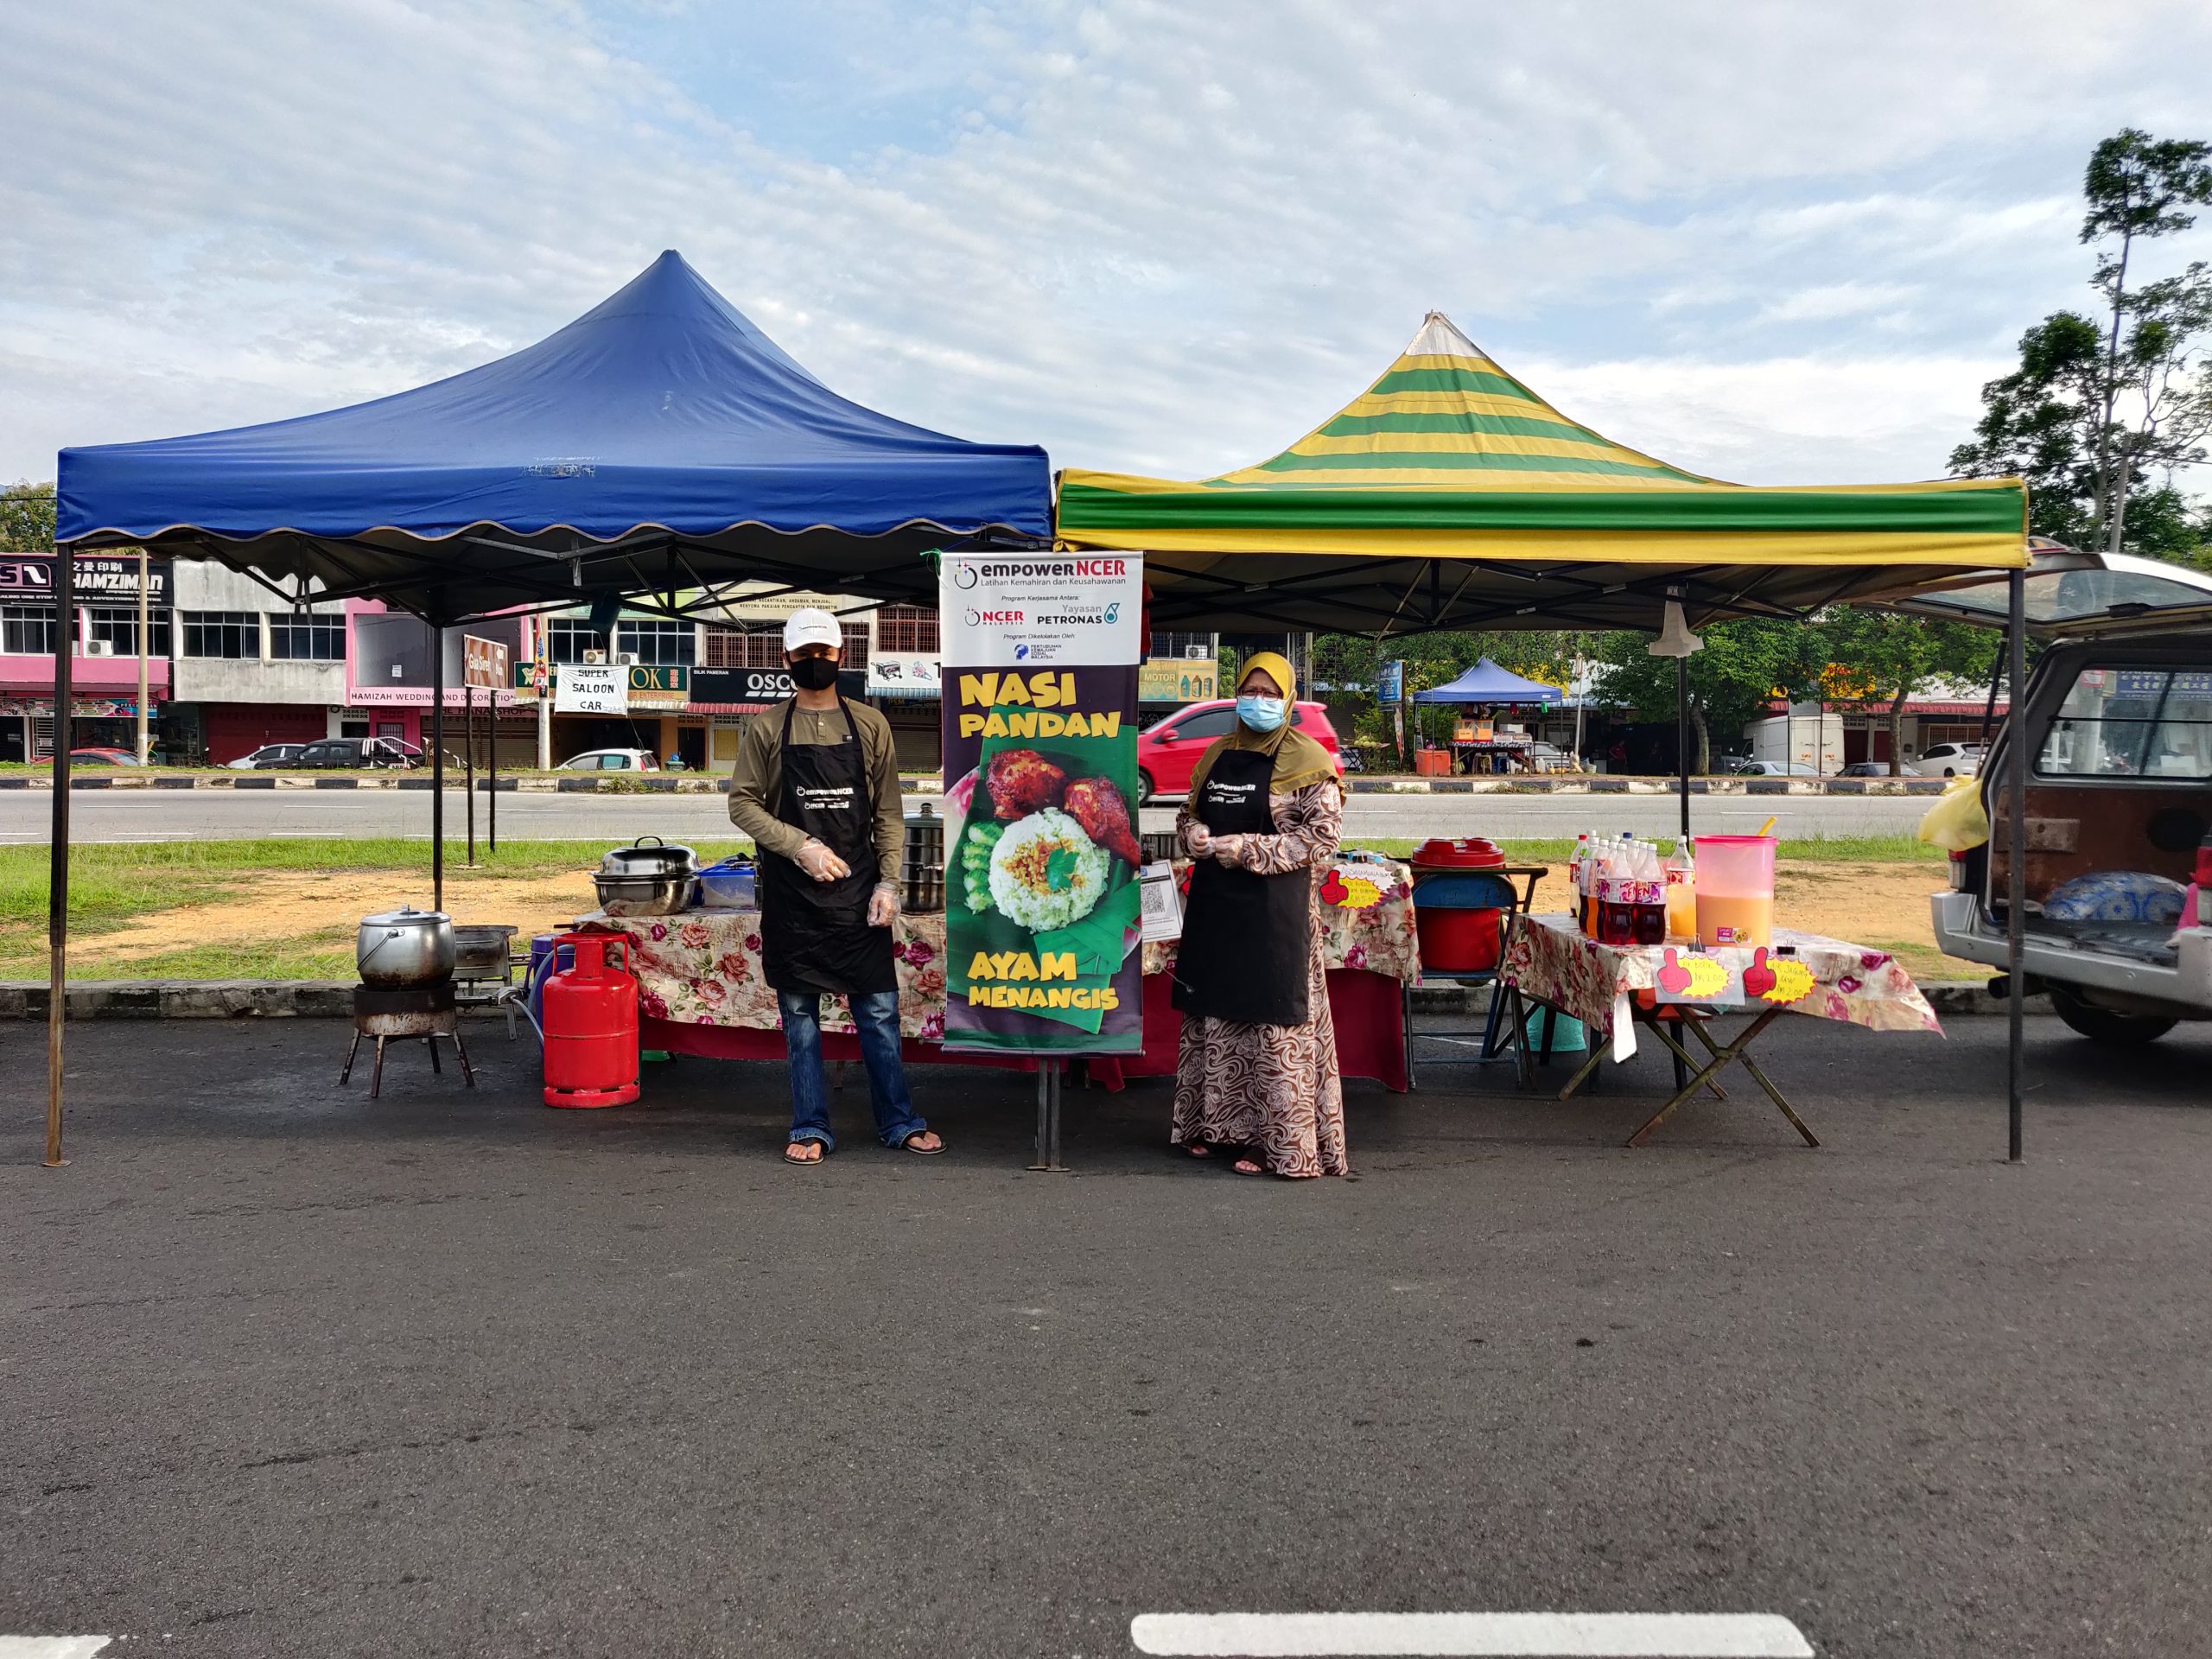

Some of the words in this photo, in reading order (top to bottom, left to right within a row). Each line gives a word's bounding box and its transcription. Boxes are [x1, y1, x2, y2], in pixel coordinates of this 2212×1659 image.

[1011, 578, 1051, 587] Kemahiran
[1052, 577, 1067, 586] dan
[1070, 577, 1126, 586] Keusahawanan
[1062, 604, 1102, 614] Yayasan
[983, 610, 1024, 621] NCER
[1037, 615, 1103, 625] PETRONAS
[578, 669, 609, 678] SUPER
[1144, 673, 1176, 683] MOTOR
[572, 683, 614, 694] SALOON
[959, 671, 1077, 709] NASI
[580, 701, 602, 710] CAR
[958, 710, 1122, 740] PANDAN
[967, 951, 1077, 982] AYAM
[968, 986, 1119, 1010] MENANGIS
